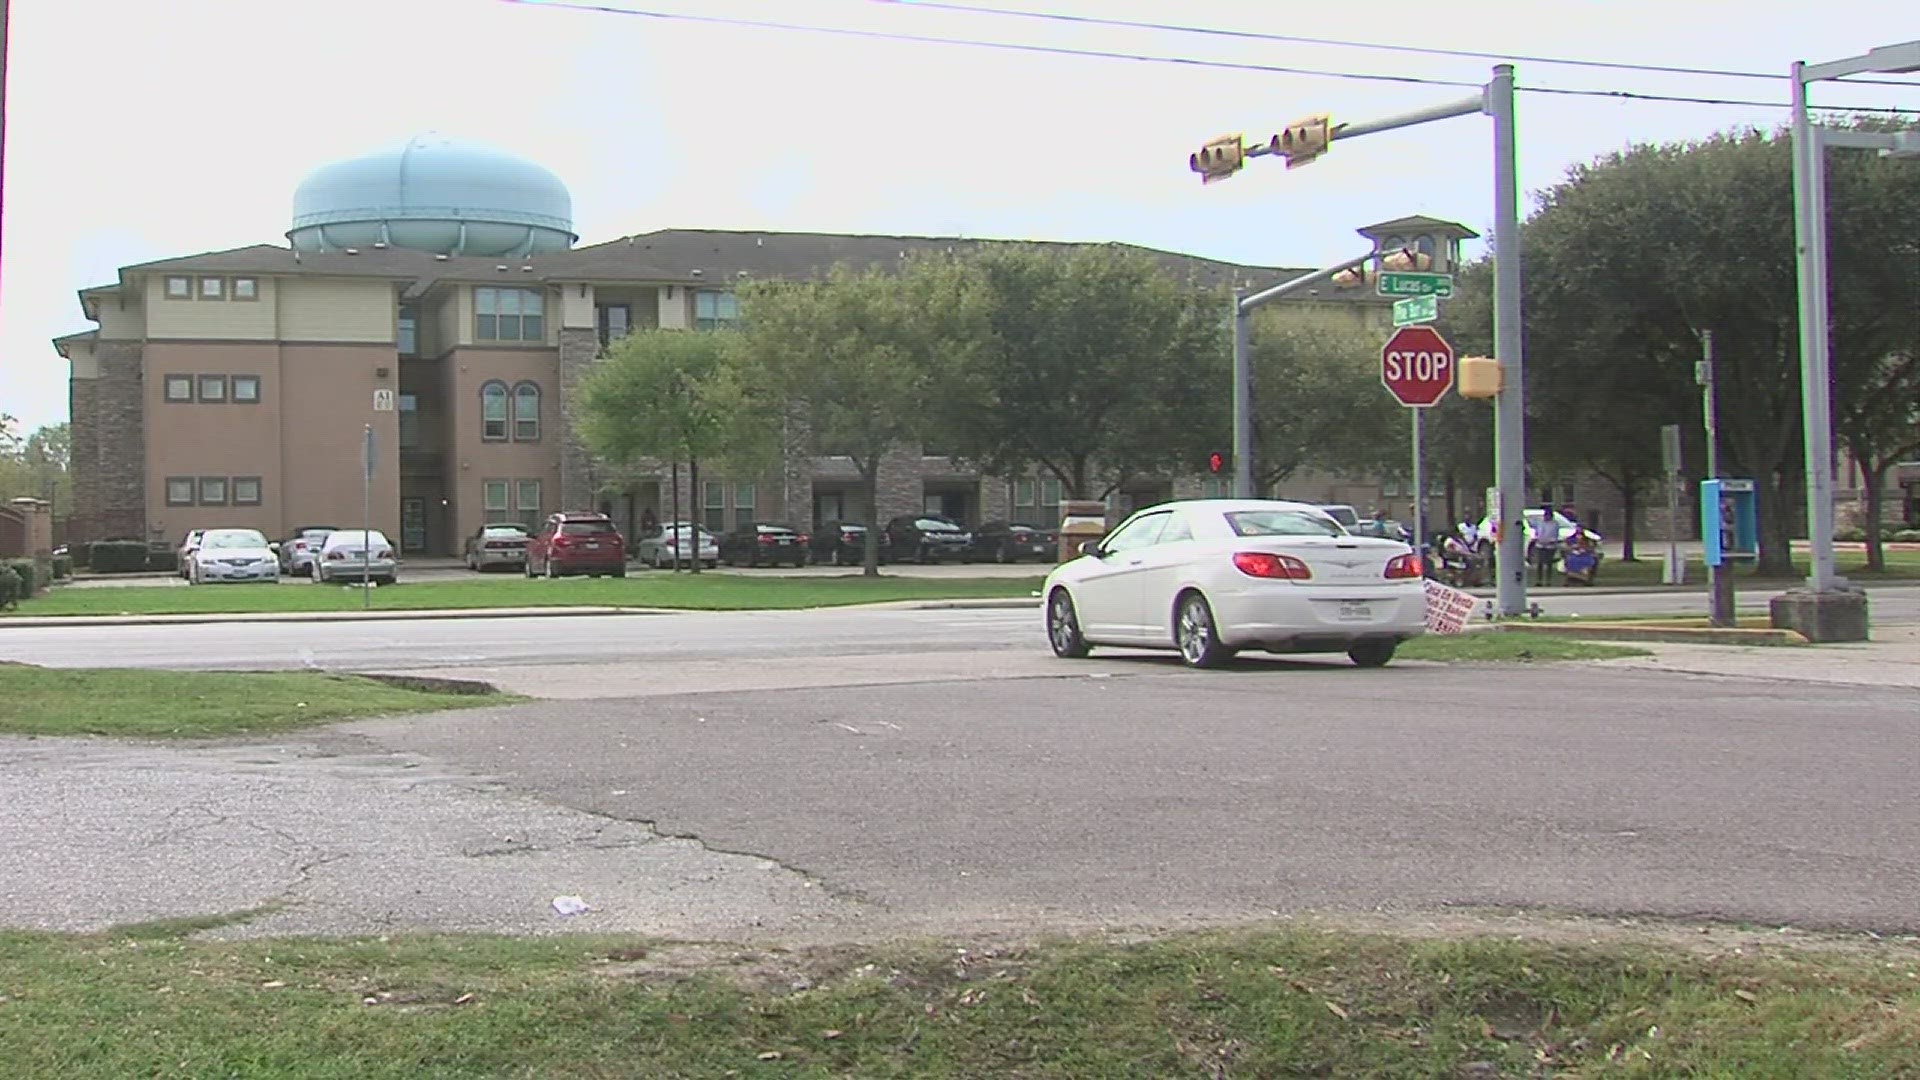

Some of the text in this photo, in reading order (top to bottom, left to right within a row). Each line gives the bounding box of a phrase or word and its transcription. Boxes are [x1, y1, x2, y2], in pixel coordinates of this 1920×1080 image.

[1381, 275, 1387, 291] E
[1393, 276, 1420, 292] Lucas
[1387, 351, 1448, 381] STOP
[1440, 588, 1451, 601] En
[1452, 592, 1474, 609] Venta
